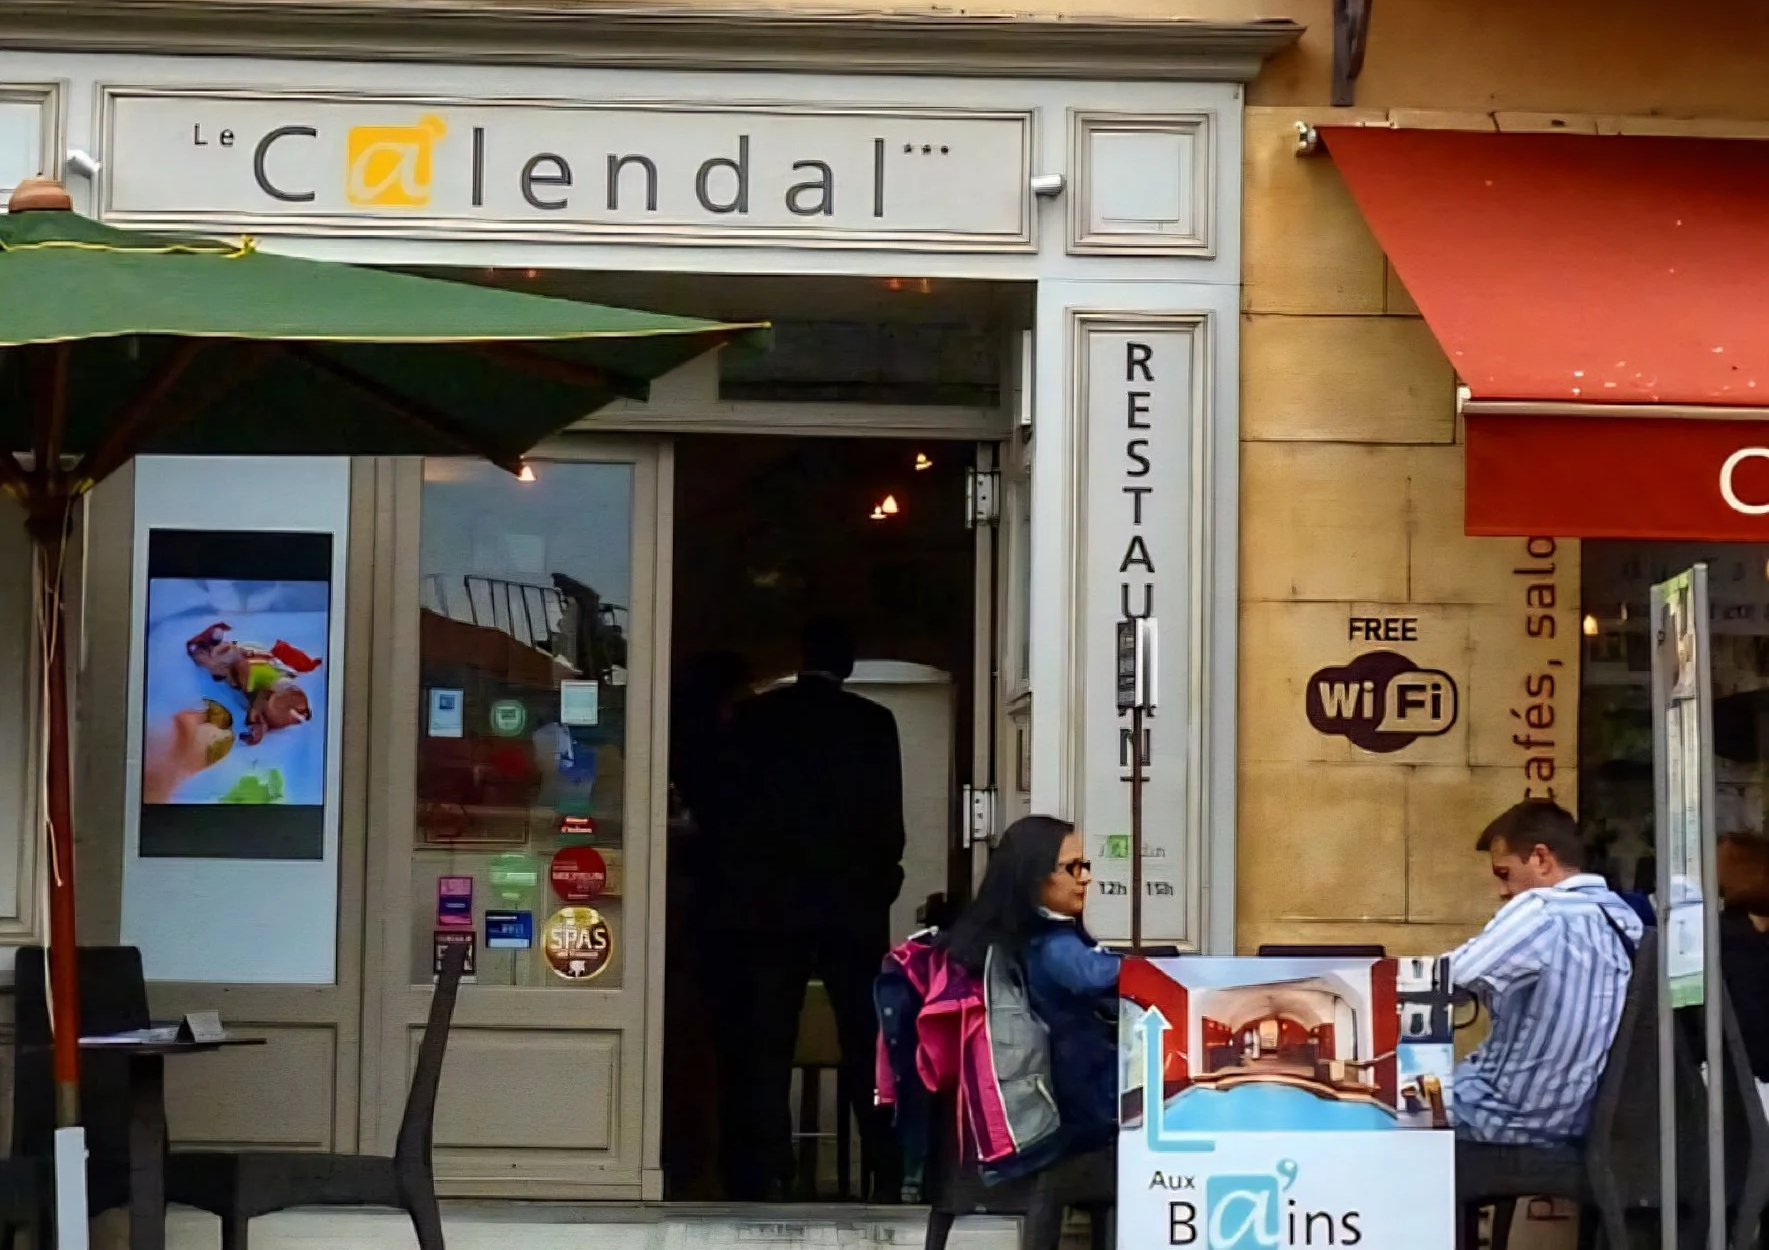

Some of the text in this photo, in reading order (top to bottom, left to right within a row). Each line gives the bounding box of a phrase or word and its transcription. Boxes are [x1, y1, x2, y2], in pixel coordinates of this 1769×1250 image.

[193, 122, 236, 148] Le
[1119, 340, 1156, 783] RESTAUN
[1349, 617, 1418, 642] FREE
[549, 926, 607, 951] SPAS
[1149, 1170, 1196, 1191] Aux
